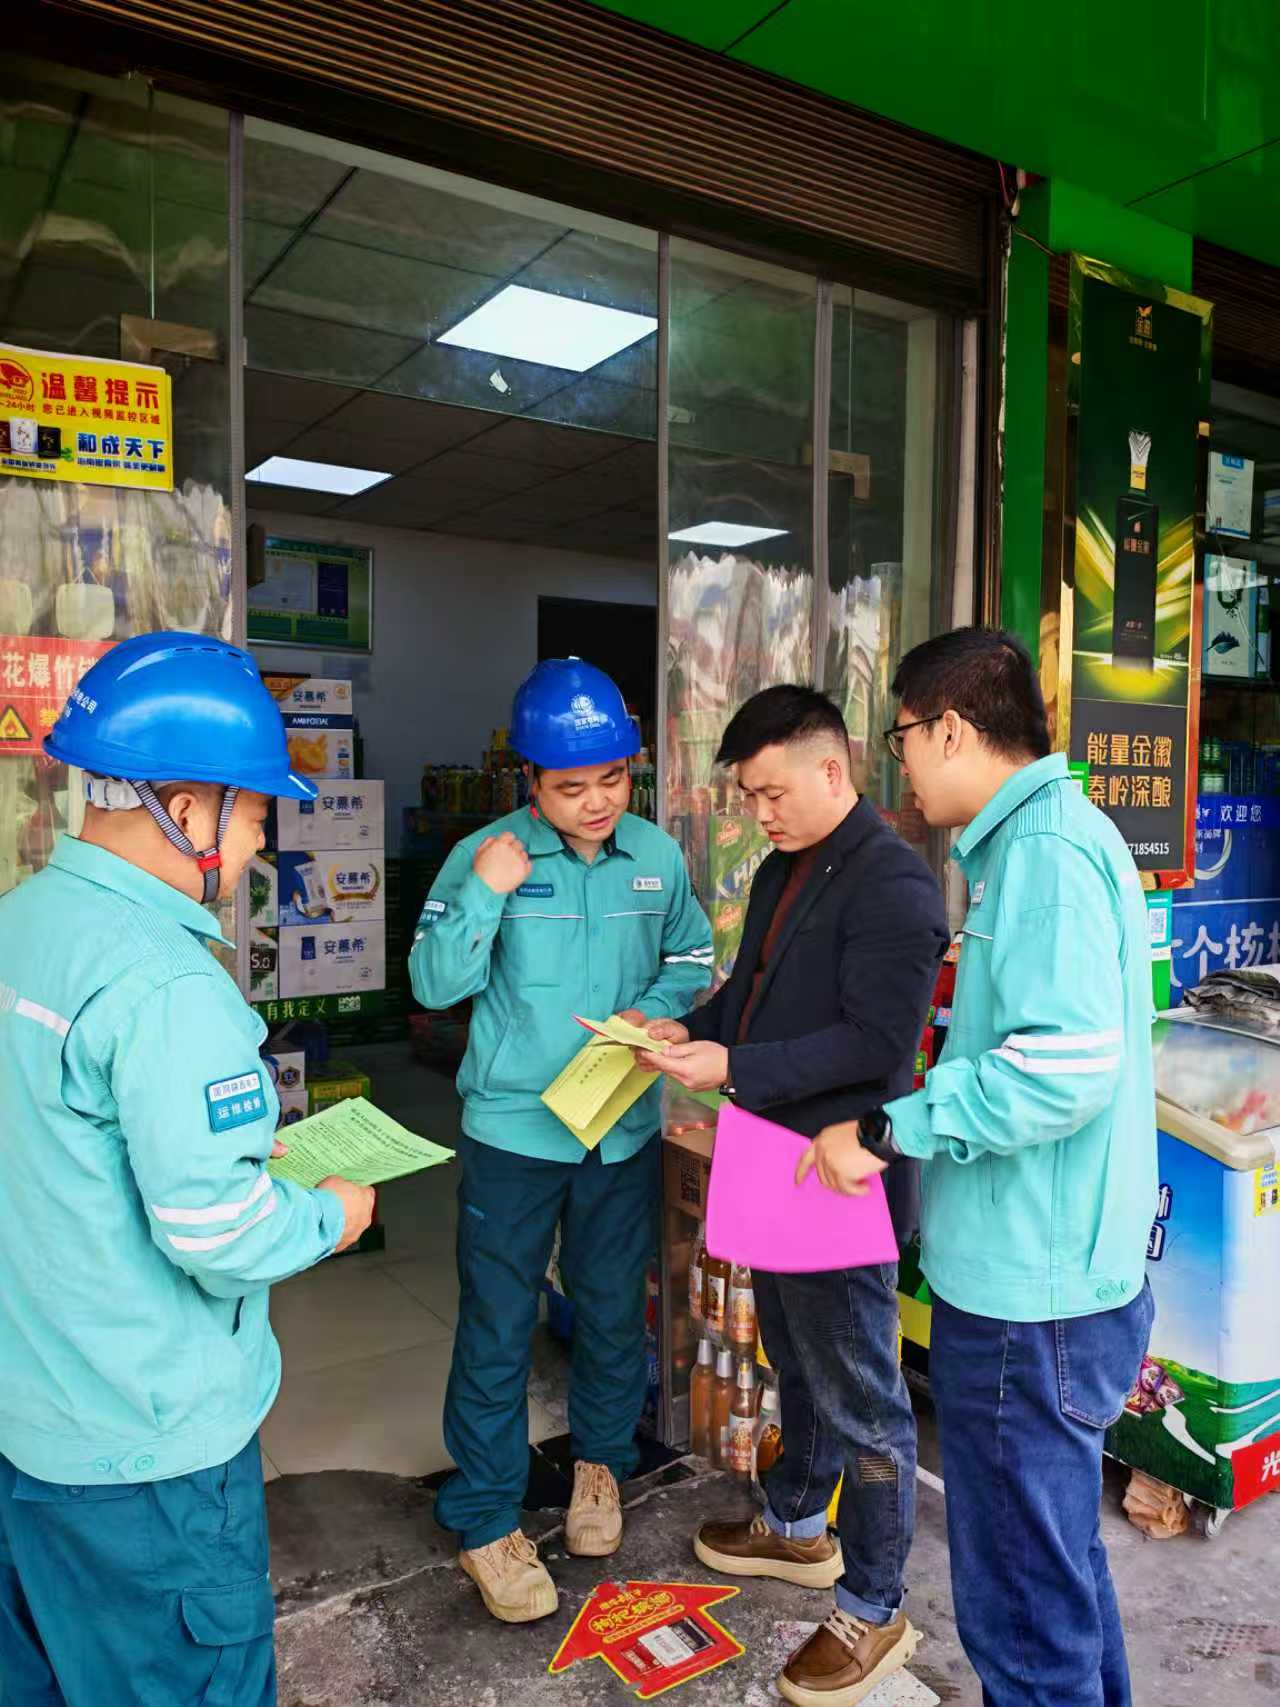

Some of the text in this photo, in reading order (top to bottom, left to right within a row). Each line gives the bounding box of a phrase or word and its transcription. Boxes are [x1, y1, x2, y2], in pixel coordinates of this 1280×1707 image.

[41, 372, 159, 409] 温馨提示
[42, 403, 160, 424] 您已进入视频监控区域
[77, 432, 164, 459] 和成天下
[1087, 733, 1172, 768] 能量金徽
[1087, 775, 1171, 808] 秦岭深酿
[321, 796, 363, 811] 安慕希
[1220, 804, 1262, 823] 欢迎您
[336, 871, 371, 885] 安慕希
[323, 937, 365, 955] 安慕希
